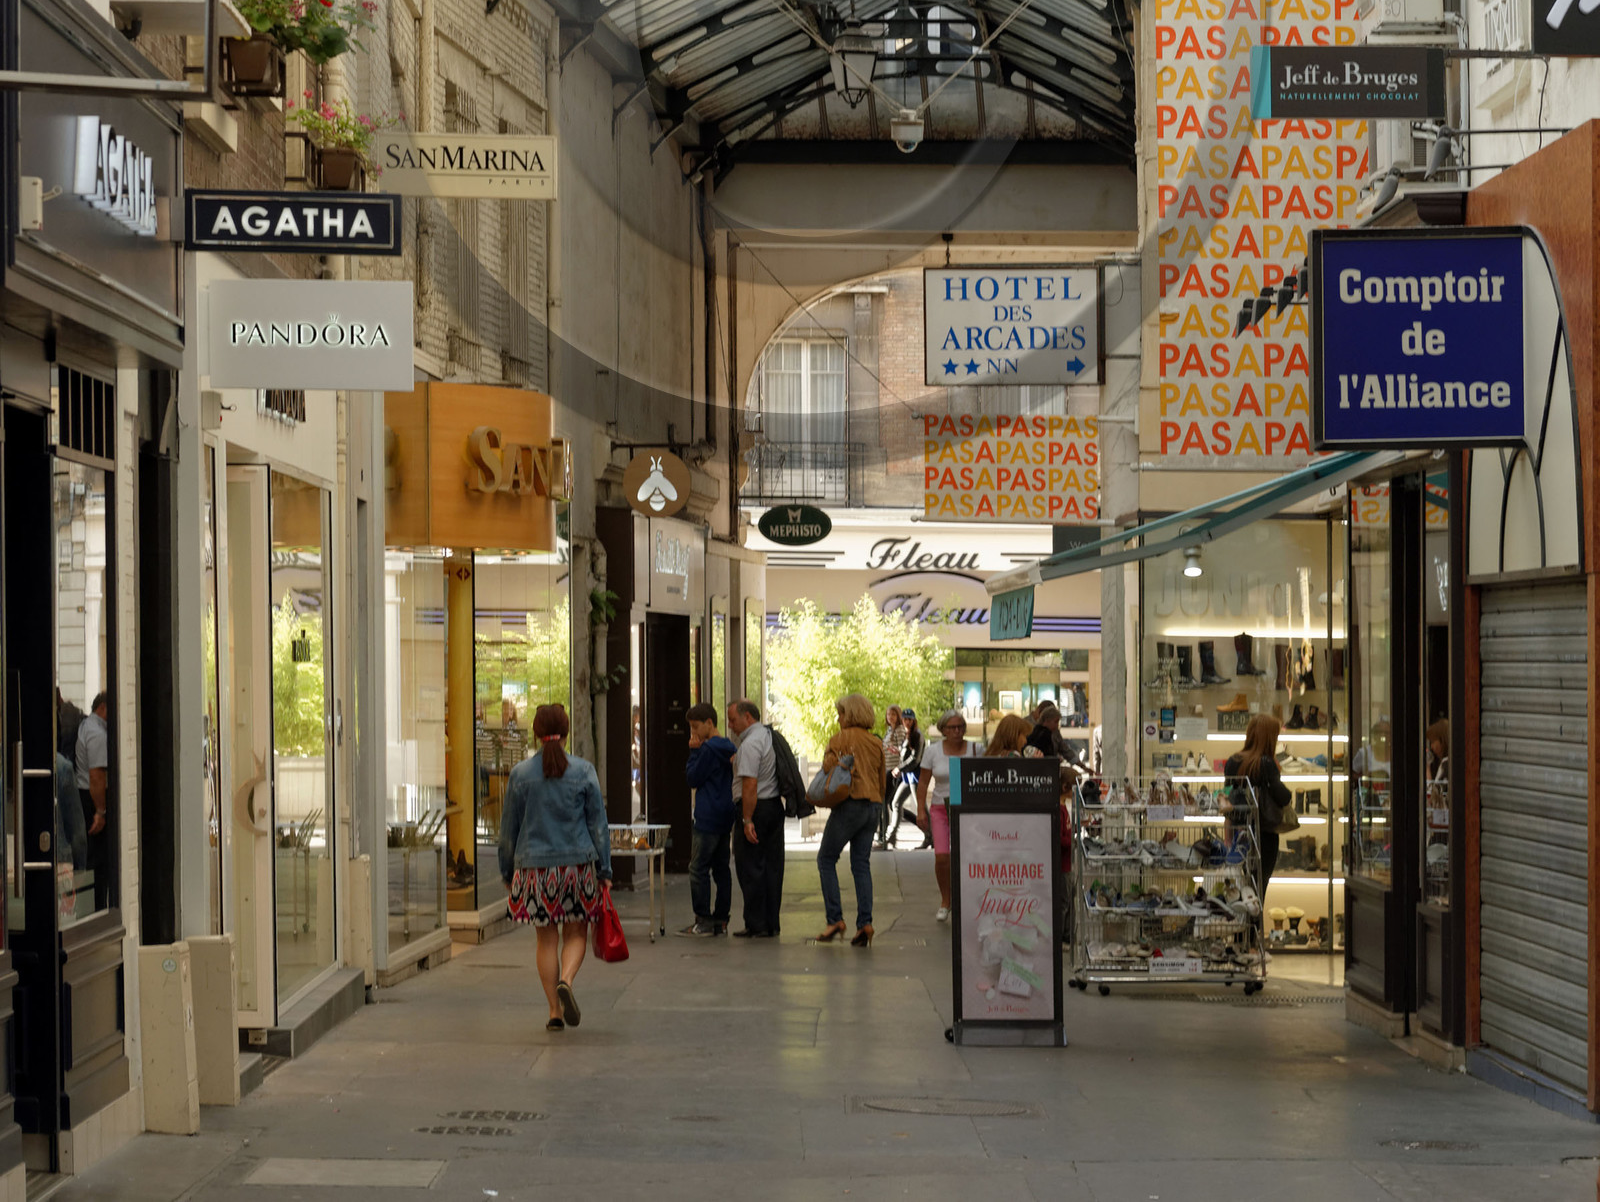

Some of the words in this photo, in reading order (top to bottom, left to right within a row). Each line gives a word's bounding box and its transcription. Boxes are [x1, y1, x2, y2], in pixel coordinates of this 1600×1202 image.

[1280, 64, 1321, 90] Jeff
[1323, 71, 1339, 85] de
[1342, 61, 1418, 92] Bruges
[1157, 105, 1368, 139] PASAPASP
[1158, 185, 1363, 219] PASAPASP
[211, 206, 375, 239] AGATHA
[943, 276, 1082, 302] HOTEL
[1339, 267, 1505, 311] Comptoir
[993, 305, 1032, 322] DES
[231, 320, 390, 348] PANDORA
[941, 325, 1086, 351] ARCADES
[1401, 321, 1446, 356] de
[987, 358, 1019, 374] NN
[1339, 373, 1511, 409] l'Alliance
[924, 414, 1098, 438] PASAPASPAS
[1160, 421, 1312, 456] PASAPA
[924, 440, 1098, 466] PASAPASPAS
[925, 467, 1098, 493] PASAPASPAS
[925, 494, 1098, 520] PASAPASPAS
[769, 523, 821, 538] MEPHISTO
[866, 536, 980, 570] Fleau
[969, 771, 993, 786] Jeff
[994, 774, 1004, 784] de
[1006, 769, 1052, 788] Bruges
[968, 864, 985, 879] UN
[988, 864, 1044, 879] MARIAGE
[975, 888, 1040, 926] Image
